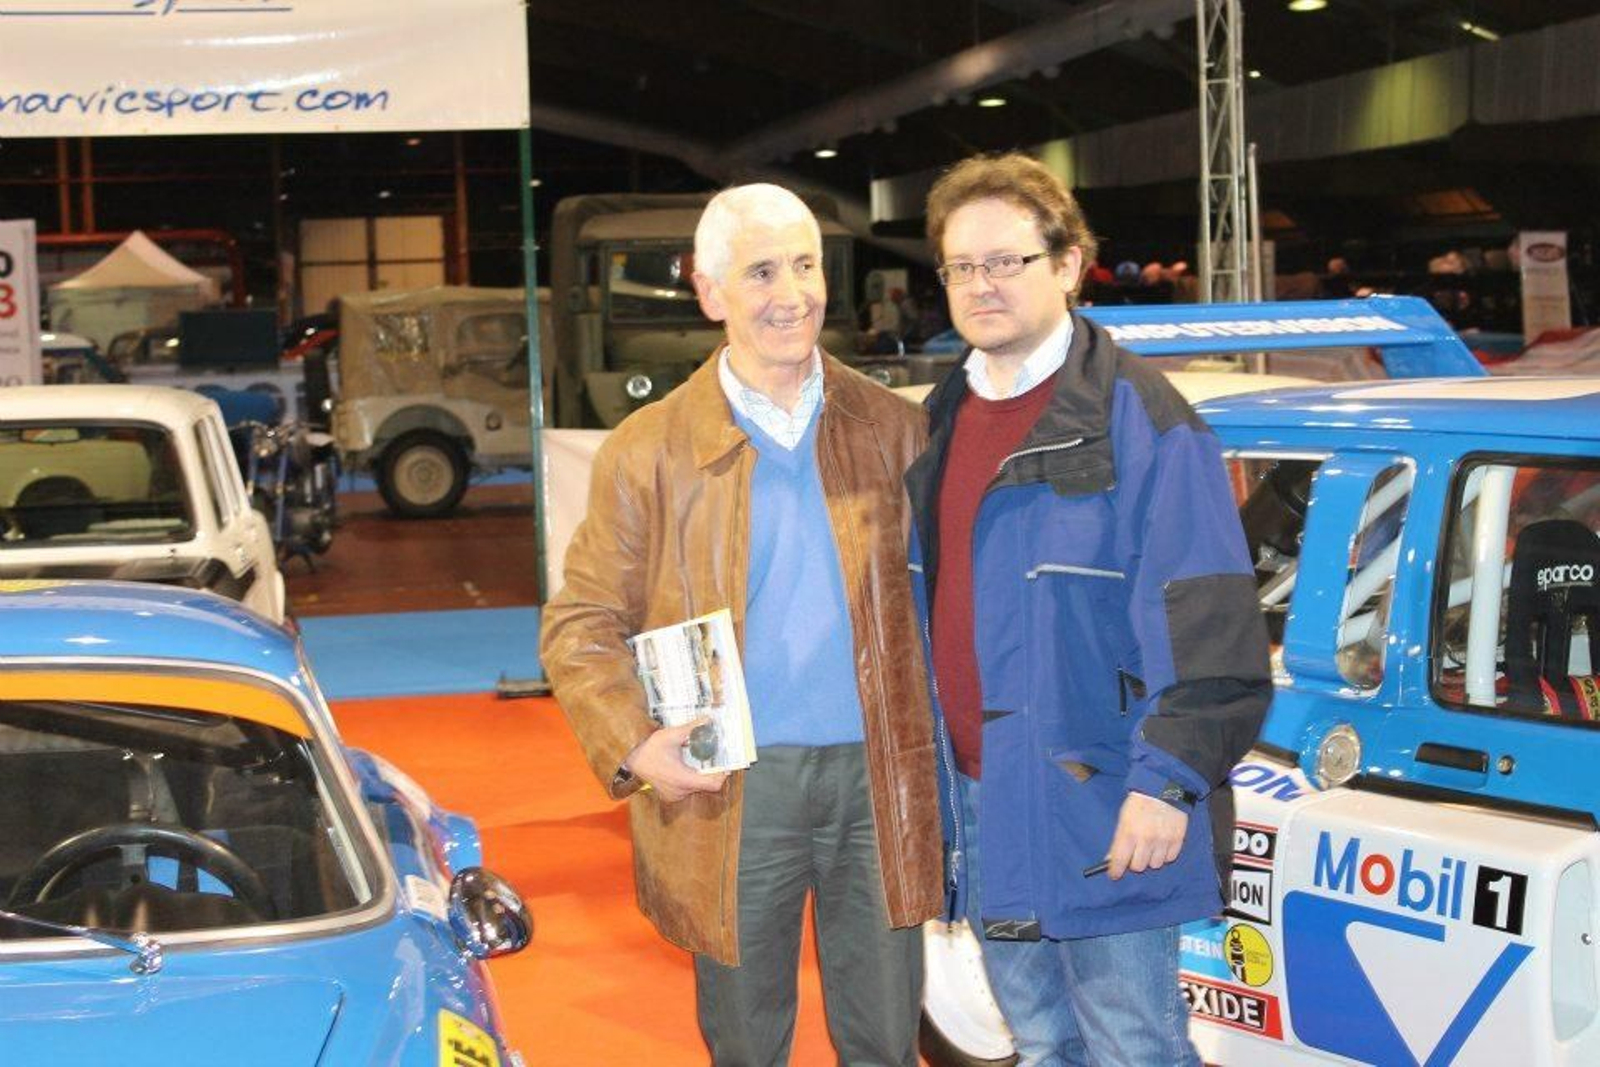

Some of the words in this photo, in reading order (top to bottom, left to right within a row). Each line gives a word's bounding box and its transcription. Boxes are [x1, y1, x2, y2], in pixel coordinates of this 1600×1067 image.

[1538, 564, 1594, 591] sparco
[1314, 831, 1467, 919] Mobil
[1488, 874, 1512, 929] 1
